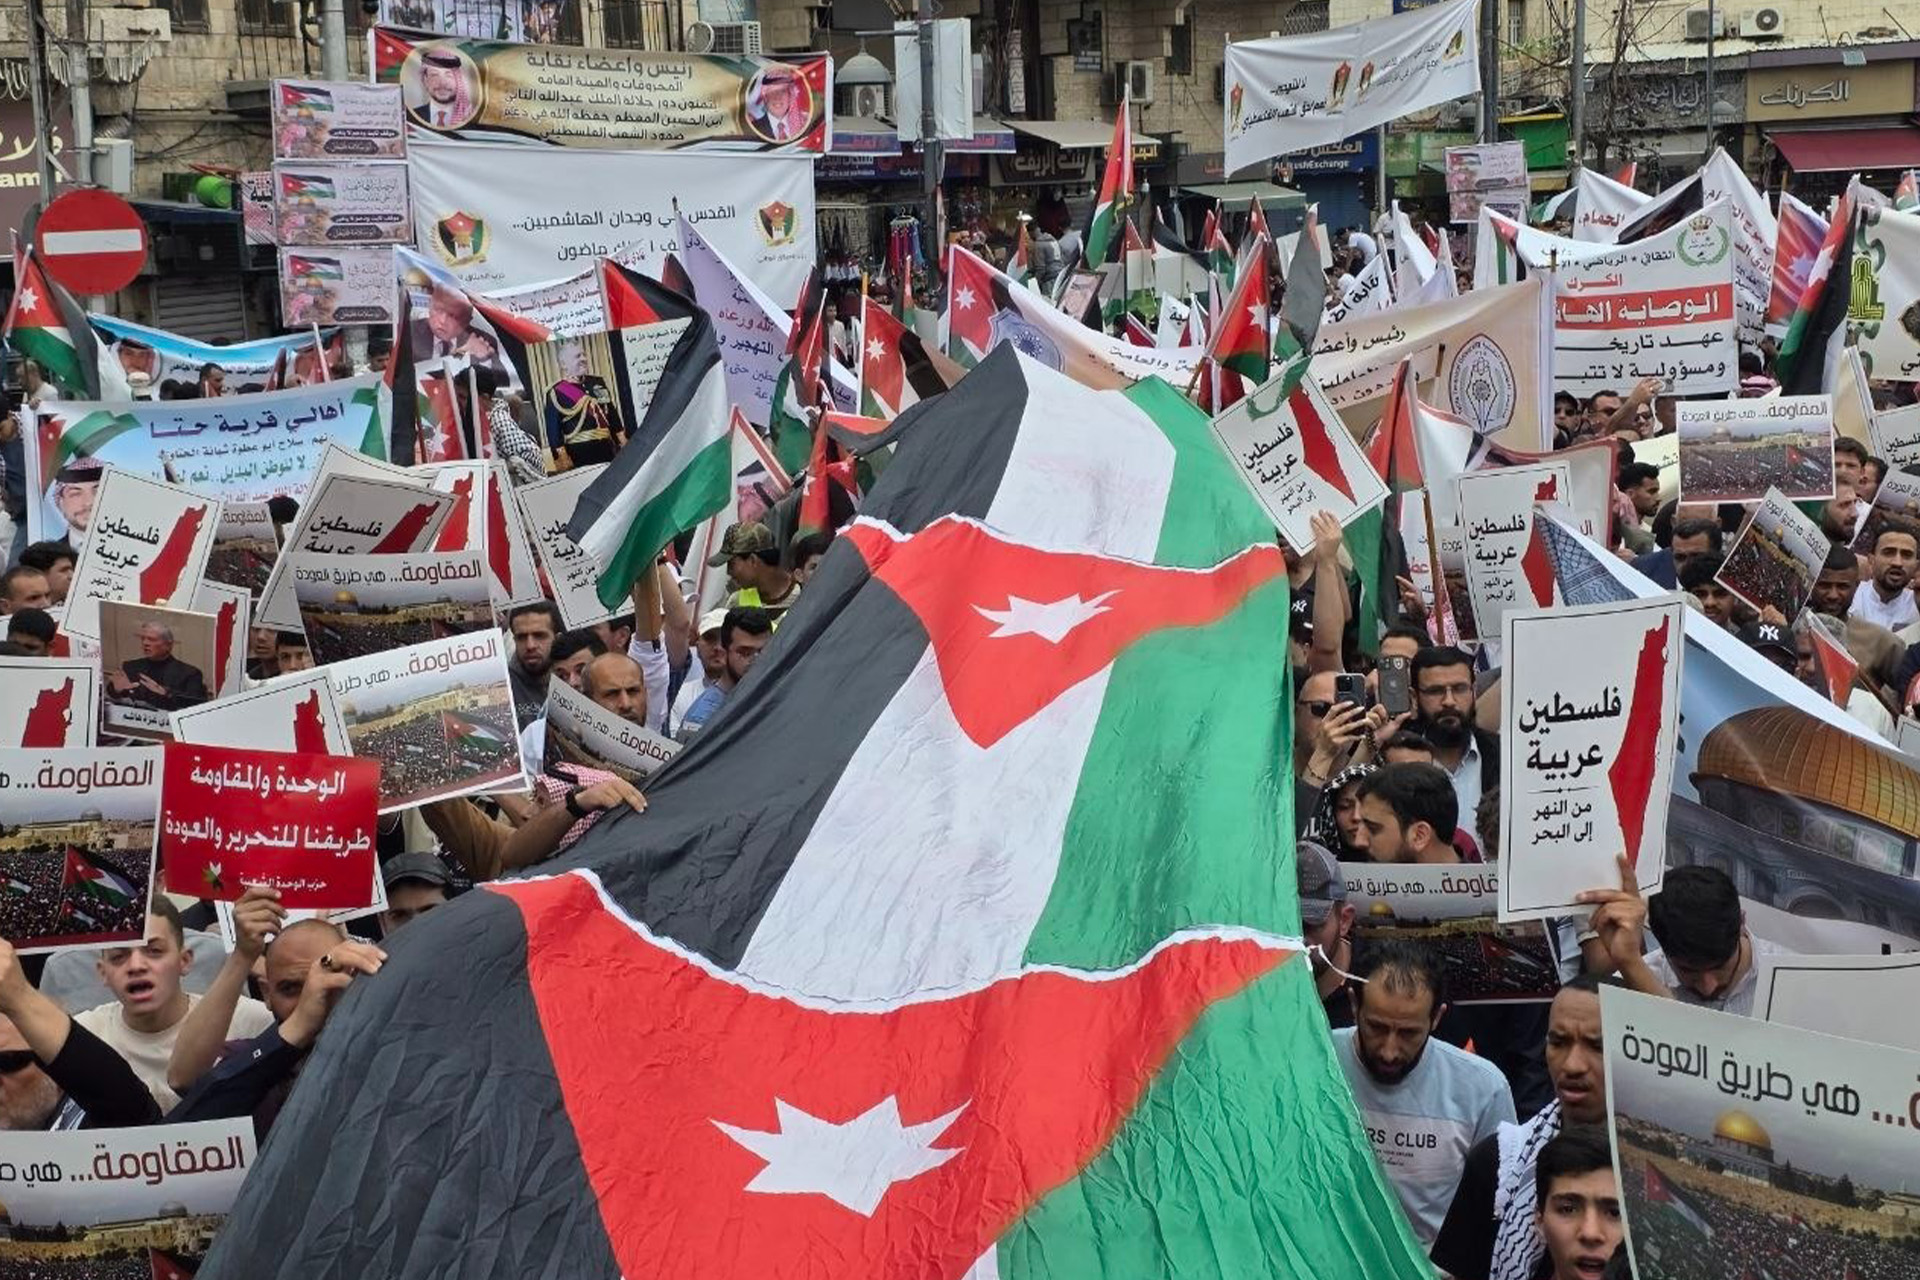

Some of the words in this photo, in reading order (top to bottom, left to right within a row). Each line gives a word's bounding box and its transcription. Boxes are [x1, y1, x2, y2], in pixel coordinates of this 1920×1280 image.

[527, 52, 572, 71] نقابة
[1760, 79, 1849, 110] الكرنك
[609, 211, 652, 228] وجدان
[688, 205, 736, 225] القدس
[557, 241, 609, 262] ماضون
[1566, 273, 1623, 292] الكرك
[1618, 290, 1719, 325] الوصاية
[730, 337, 774, 357] التهجير
[1313, 331, 1359, 355] وأعض
[1362, 324, 1407, 351] رئيس
[1554, 333, 1655, 355] تاريخ
[1660, 331, 1724, 350] عهد
[1554, 364, 1608, 384] تتب
[1612, 361, 1625, 379] لا
[1628, 360, 1727, 382] ومسؤولية
[218, 410, 279, 437] قرية
[285, 399, 346, 433] أهالي
[1738, 409, 1757, 422] هي
[150, 417, 209, 439] حتا
[1243, 423, 1294, 470] فلسطين
[1886, 433, 1920, 453] لسطين
[1256, 452, 1299, 485] عربية
[1278, 487, 1296, 506] النهر
[1292, 480, 1306, 494] من
[1303, 487, 1317, 501] إلى
[1287, 496, 1304, 516] البحر
[97, 515, 160, 546] فلسطين
[310, 514, 384, 538] فلسطين
[1468, 513, 1526, 541] فلسطين
[95, 538, 140, 569] عربية
[552, 542, 585, 560] ربية
[1475, 542, 1518, 566] عربية
[295, 566, 331, 582] العودة
[333, 566, 363, 585] طريق
[364, 570, 387, 586] هي
[583, 565, 596, 576] من
[111, 580, 126, 592] من
[1483, 577, 1501, 591] النهر
[1502, 577, 1513, 588] من
[1485, 590, 1504, 602] البحر
[1505, 590, 1517, 602] إلى
[1759, 624, 1780, 642] NY
[365, 668, 391, 691] هي
[1519, 685, 1623, 734] فلسطين
[592, 721, 610, 737] هي
[1526, 739, 1604, 780] عربية
[190, 756, 271, 798] والمقاومة
[276, 767, 346, 802] الوحدة
[1531, 799, 1568, 821] النهر
[1571, 801, 1593, 818] من
[165, 810, 222, 849] والعودة
[225, 823, 300, 851] للتحرير
[1531, 823, 1571, 845] البحر
[1573, 821, 1593, 843] إلى
[304, 824, 371, 857] طريقنا
[274, 877, 305, 890] الوحدة
[305, 877, 328, 891] حزب
[1366, 878, 1399, 898] طريق
[1400, 881, 1425, 898] هي
[1622, 1024, 1709, 1080] العودة
[1716, 1050, 1793, 1102] طريق
[1802, 1080, 1861, 1117] هي
[1393, 1131, 1438, 1149] CLUB
[70, 1134, 246, 1186] المقاومة...
[22, 1159, 63, 1189] هي
